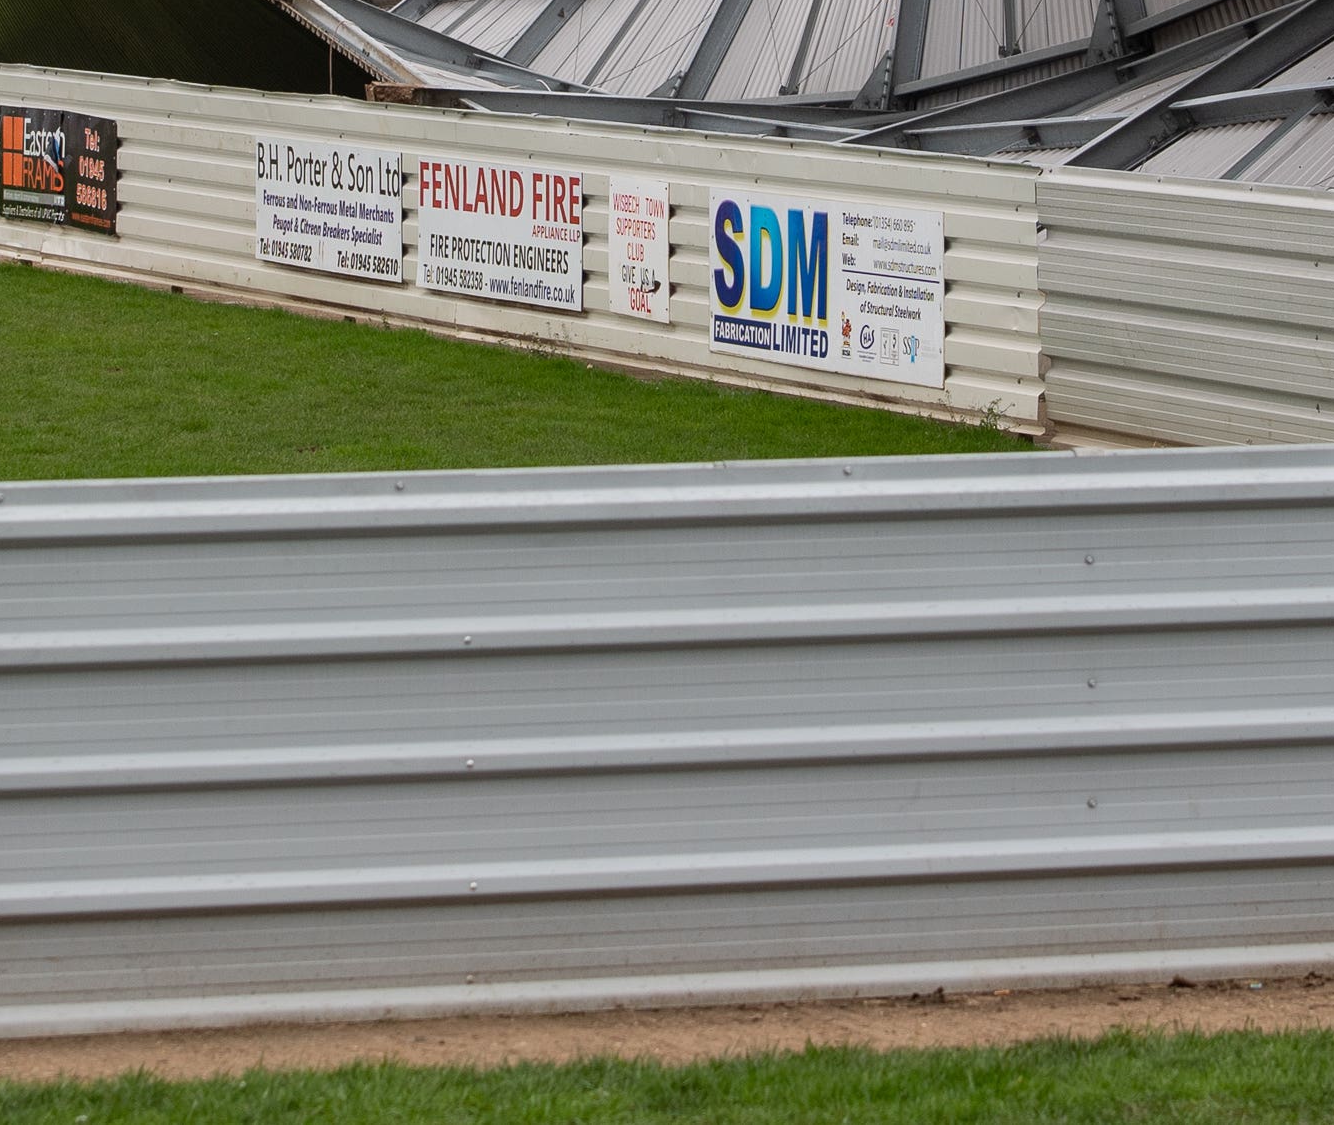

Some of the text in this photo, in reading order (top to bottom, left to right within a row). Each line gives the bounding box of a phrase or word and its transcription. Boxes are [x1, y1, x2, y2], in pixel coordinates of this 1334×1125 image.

[85, 127, 100, 153] Tel:
[257, 142, 400, 197] B.H. Porter & Son Ltd
[419, 161, 580, 225] FENLAND FIRE
[613, 193, 665, 219] WISBECH TOWN
[263, 189, 394, 224] Ferrous and Non-Ferrous Metal Merchants
[273, 213, 293, 236] Peugot
[293, 217, 299, 234] &
[322, 221, 350, 241] Breakers
[351, 226, 382, 247] Specialist
[532, 224, 581, 243] APPLIANCE LLP
[616, 217, 656, 241] SUPPORTERS
[842, 212, 873, 229] Telephone:
[260, 238, 313, 263] Tel: 01945 580782
[627, 242, 645, 262] CLUB
[842, 233, 859, 246] Email:
[337, 250, 398, 276] Tel: 01945 582610
[430, 234, 569, 275] FIRE PROTECTION ENGINEERS
[714, 199, 828, 321] SDM
[842, 253, 937, 276] Web: www.sdmstructures.com
[423, 263, 435, 283] Tel:
[436, 266, 457, 286] 01945
[459, 269, 483, 291] 582358
[489, 276, 575, 304] www.fenlandfire.co.uk
[622, 264, 636, 284] GIVE
[640, 266, 649, 286] US
[846, 278, 935, 302] Design, Fabrication & Installation
[860, 300, 921, 320] of Structural Steelwork
[715, 321, 771, 348] FABRICATION
[773, 323, 829, 359] LIMITED
[860, 324, 875, 350] CHAS
